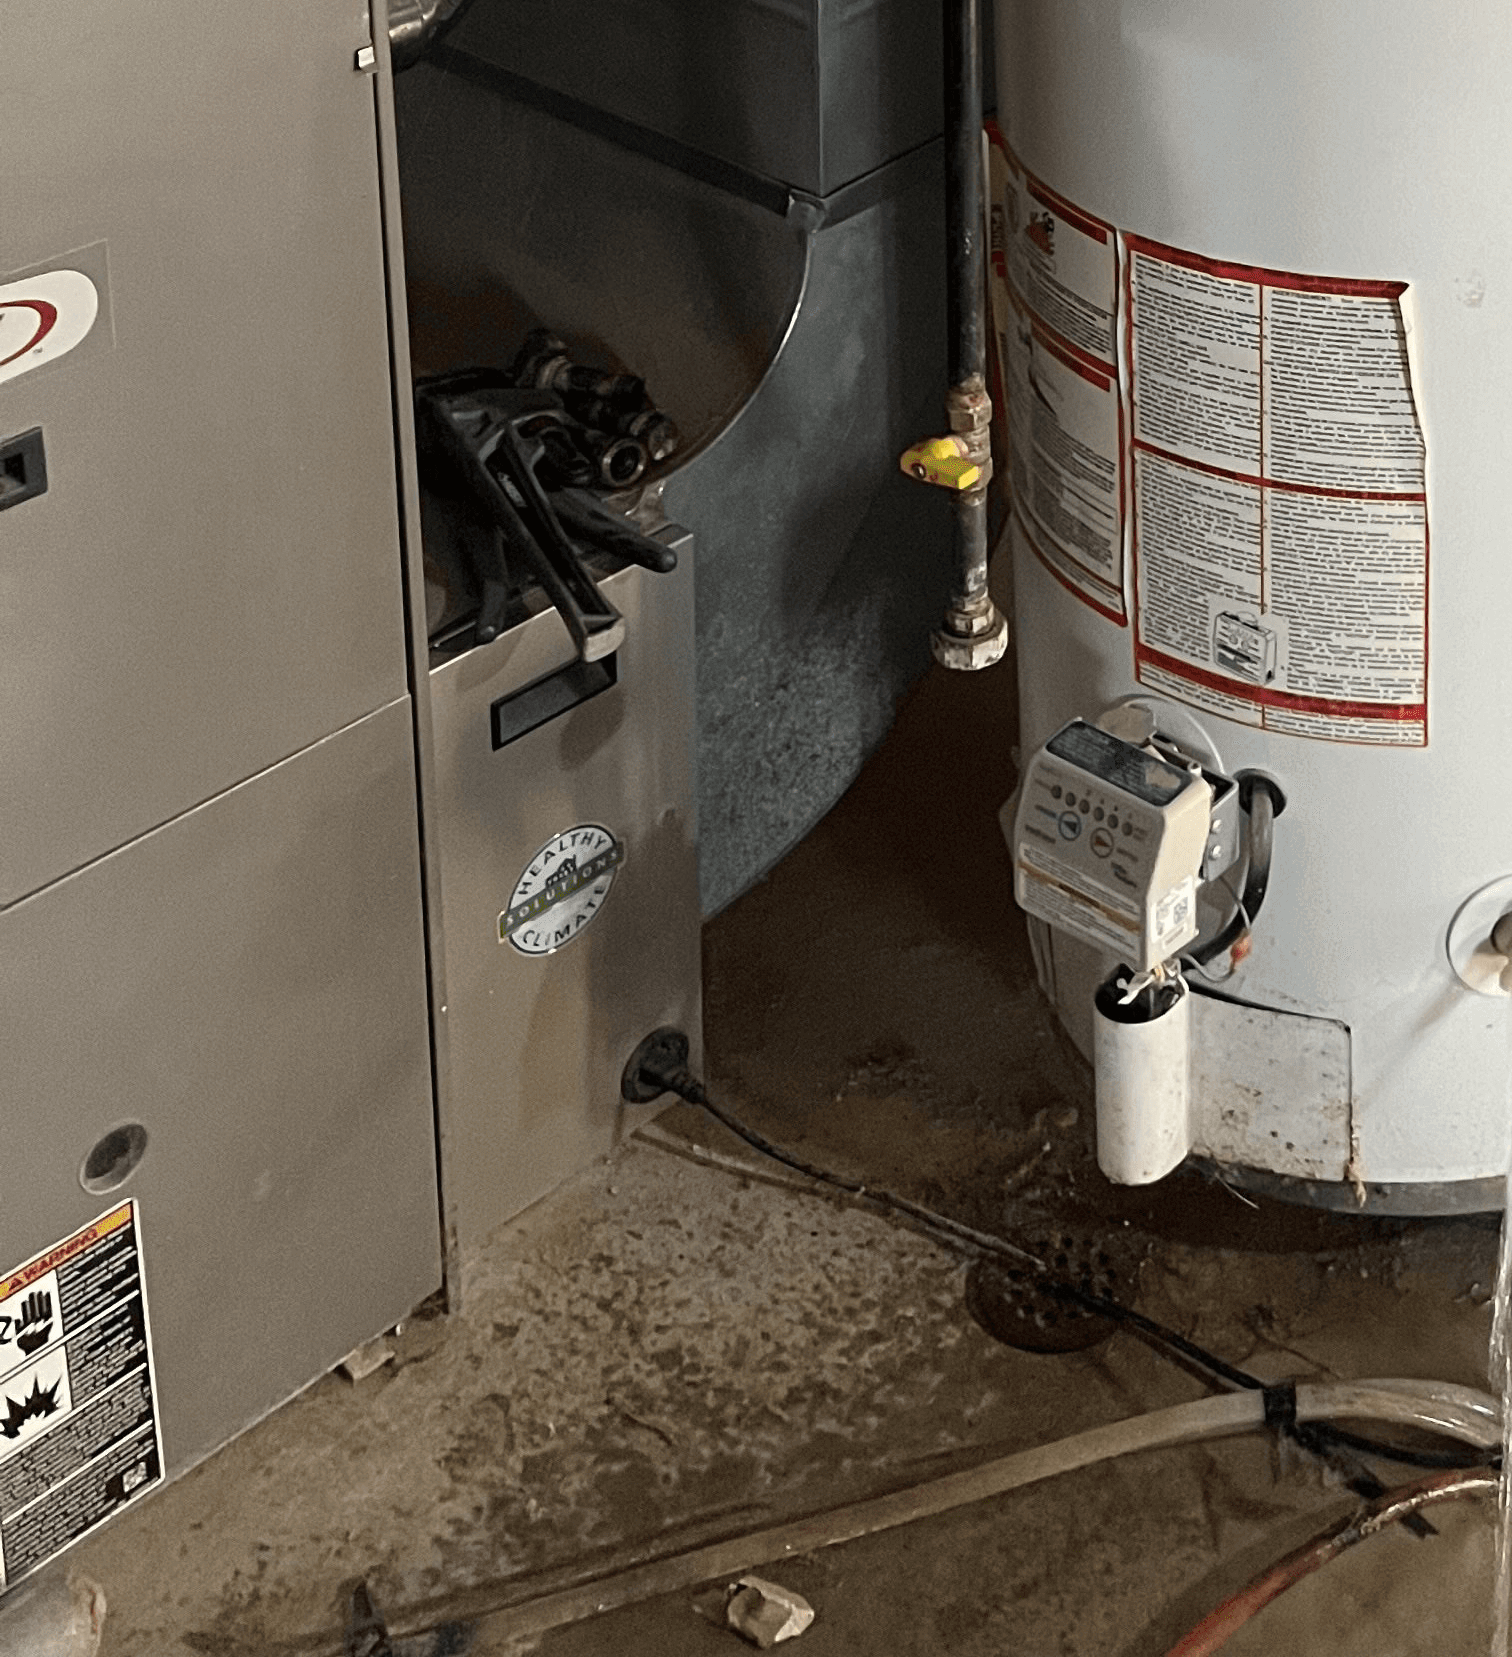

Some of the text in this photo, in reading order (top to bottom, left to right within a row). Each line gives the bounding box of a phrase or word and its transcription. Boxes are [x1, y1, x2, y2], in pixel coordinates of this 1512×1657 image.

[506, 848, 617, 927] SOLUTIONS
[518, 831, 607, 895] HEALTHY
[522, 886, 605, 947] CLIMATE
[22, 1227, 98, 1281] WARNING
